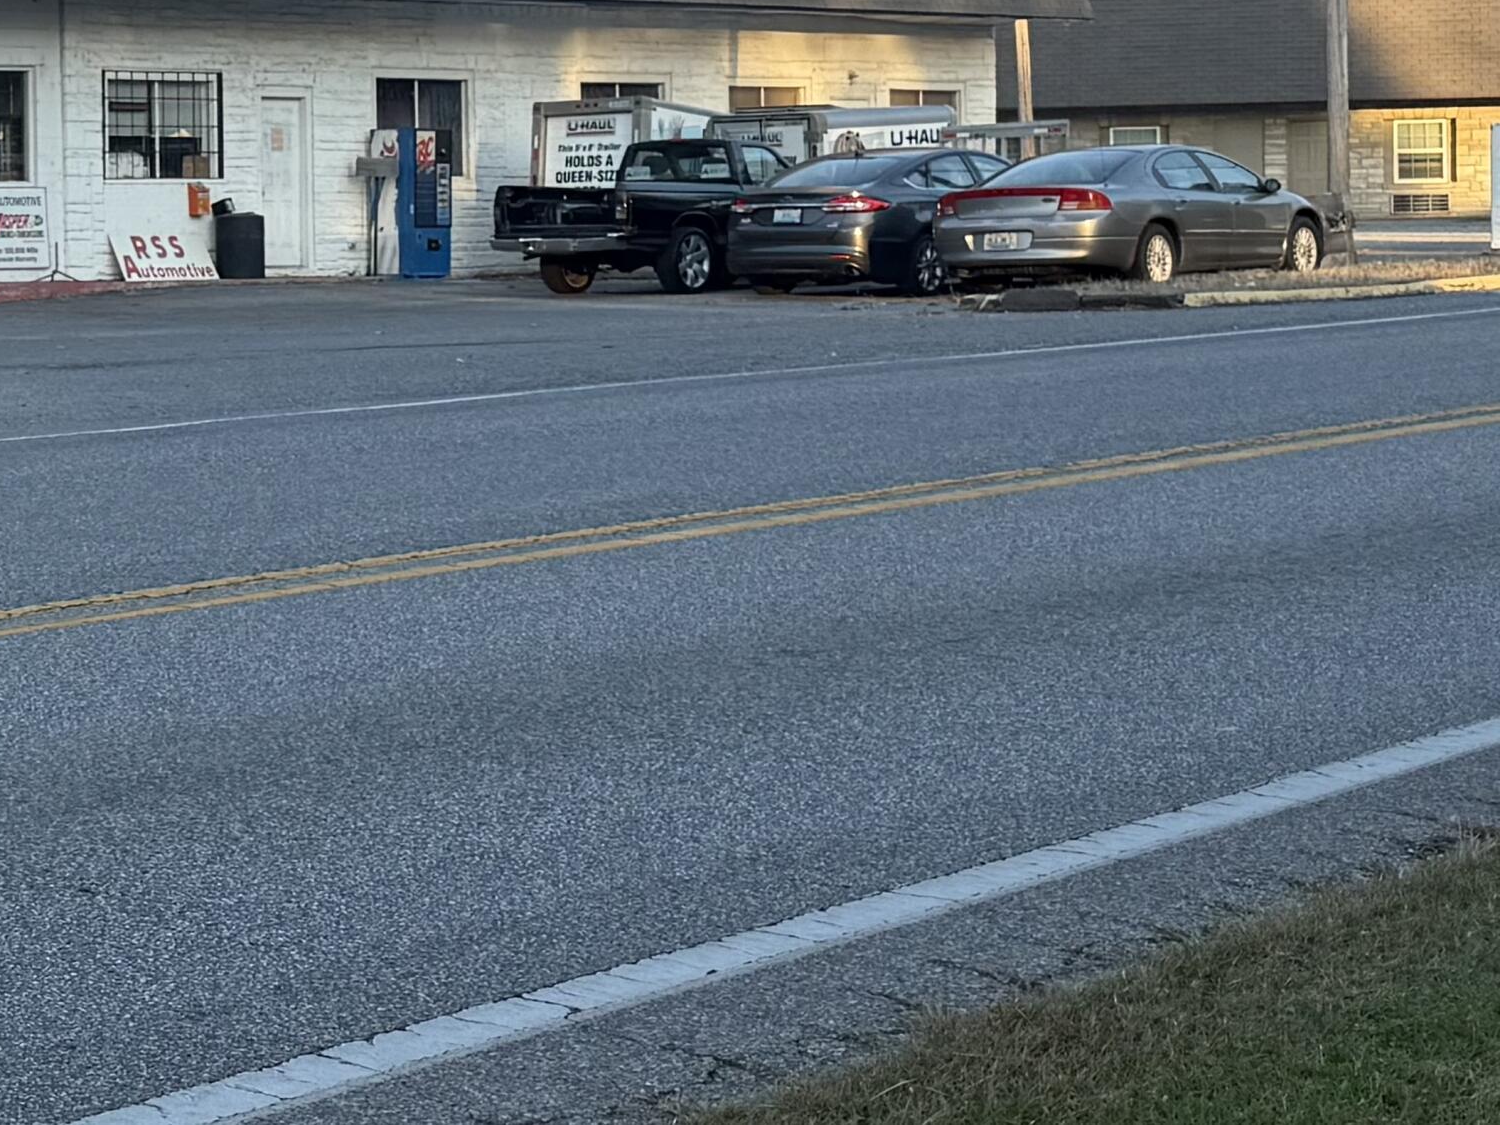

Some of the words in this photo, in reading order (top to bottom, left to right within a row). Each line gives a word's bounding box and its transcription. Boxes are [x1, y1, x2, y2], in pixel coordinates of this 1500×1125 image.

[567, 120, 614, 131] U-HAUL
[890, 127, 940, 146] U-HAU
[565, 155, 602, 167] HOLDS
[605, 154, 614, 166] A
[555, 169, 615, 184] QUEEN-SIZ
[123, 255, 216, 279] Automotive
